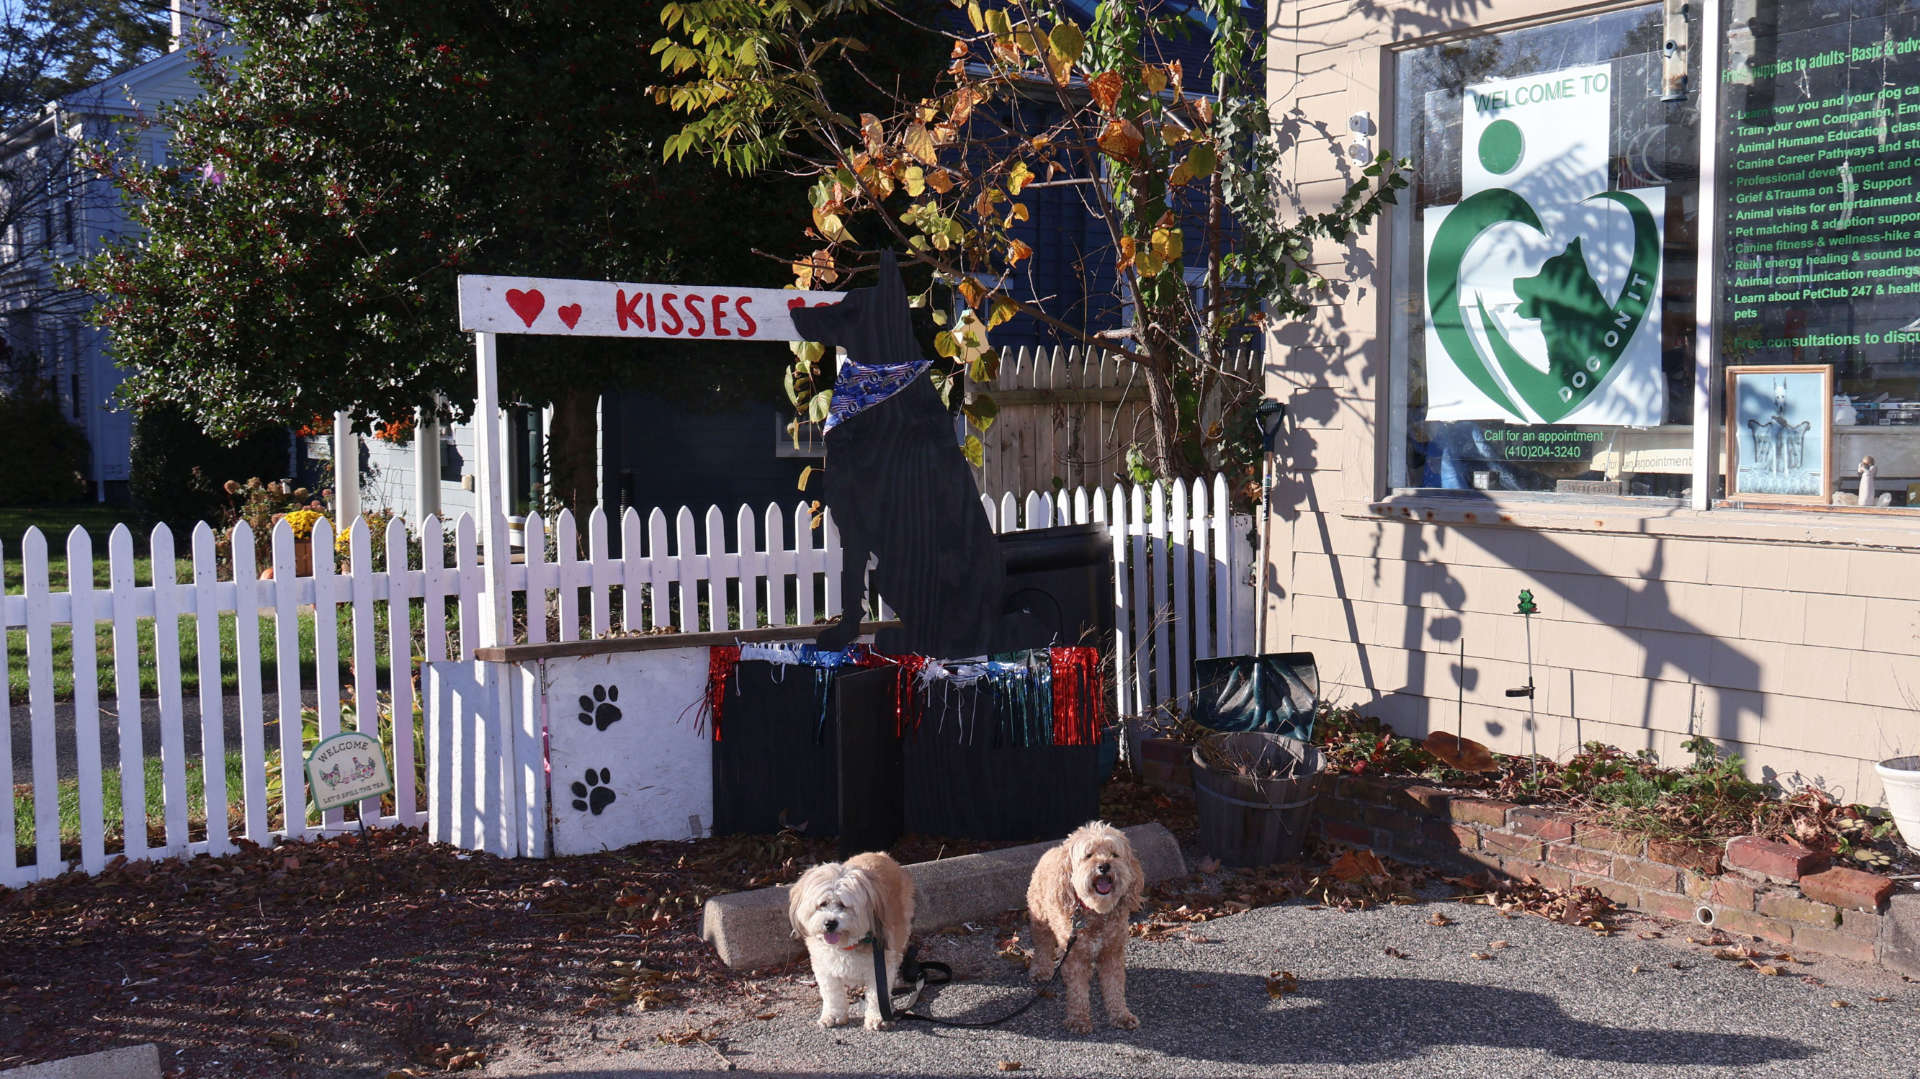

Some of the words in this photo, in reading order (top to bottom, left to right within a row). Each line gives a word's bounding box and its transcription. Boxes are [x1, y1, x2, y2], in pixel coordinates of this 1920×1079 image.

[1752, 59, 1793, 81] puppies
[1796, 57, 1807, 71] to
[1884, 40, 1894, 56] &
[1473, 78, 1576, 112] WELCOME
[1582, 72, 1609, 95] TO
[1797, 101, 1819, 114] you
[1822, 94, 1844, 108] and
[1847, 92, 1875, 107] your
[1878, 88, 1902, 100] dog
[1737, 126, 1764, 136] Train
[1767, 121, 1793, 135] your
[1795, 118, 1819, 129] own
[1822, 108, 1895, 125] Companion,
[1737, 139, 1775, 153] Animal
[1777, 135, 1824, 149] Humane
[1827, 126, 1888, 142] Education
[1736, 158, 1774, 170] Canine
[1778, 153, 1815, 165] Career
[1818, 145, 1875, 160] Pathways
[1878, 140, 1901, 153] and
[1736, 169, 1805, 187] Professional
[1887, 157, 1910, 170] and
[1736, 191, 1763, 204] Grief
[1819, 185, 1833, 195] on
[1862, 175, 1912, 191] Support
[1735, 207, 1774, 220] Animal
[1776, 204, 1807, 216] visits
[1809, 202, 1826, 214] for
[1828, 193, 1913, 212] entertainment
[1735, 226, 1754, 237] Pet
[1756, 222, 1808, 235] matching
[1810, 219, 1819, 230] &
[1822, 215, 1874, 229] adoption
[1735, 241, 1773, 254] Canine
[1775, 239, 1814, 251] fitness
[1817, 236, 1826, 247] &
[1829, 230, 1910, 246] wellness-hike
[1735, 258, 1761, 270] Reiki
[1765, 256, 1803, 269] energy
[1806, 253, 1849, 265] healing
[1851, 250, 1860, 261] &
[1864, 248, 1902, 261] sound
[1734, 274, 1772, 287] Animal
[1775, 269, 1863, 285] communication
[1866, 265, 1920, 278] readings
[1734, 293, 1765, 303] Learn
[1767, 290, 1800, 302] about
[1803, 287, 1849, 300] PetClub
[1851, 285, 1872, 297] 247
[1875, 284, 1884, 295] &
[615, 288, 757, 338] KISSES
[1734, 308, 1758, 321] pets
[1558, 355, 1601, 403] DOG
[1603, 309, 1633, 348] ON
[1627, 272, 1648, 301] IT
[1734, 336, 1762, 349] Free
[1767, 333, 1861, 348] consultations
[1865, 332, 1880, 345] to
[1484, 430, 1504, 441] Call
[1506, 430, 1520, 441] for
[1522, 432, 1535, 441] an
[1539, 430, 1604, 443] appointment
[1504, 446, 1581, 459] (410)204-3240
[318, 741, 369, 763] WELCOME
[322, 794, 341, 804] LET'S
[359, 785, 372, 793] THE
[373, 781, 385, 790] TEA
